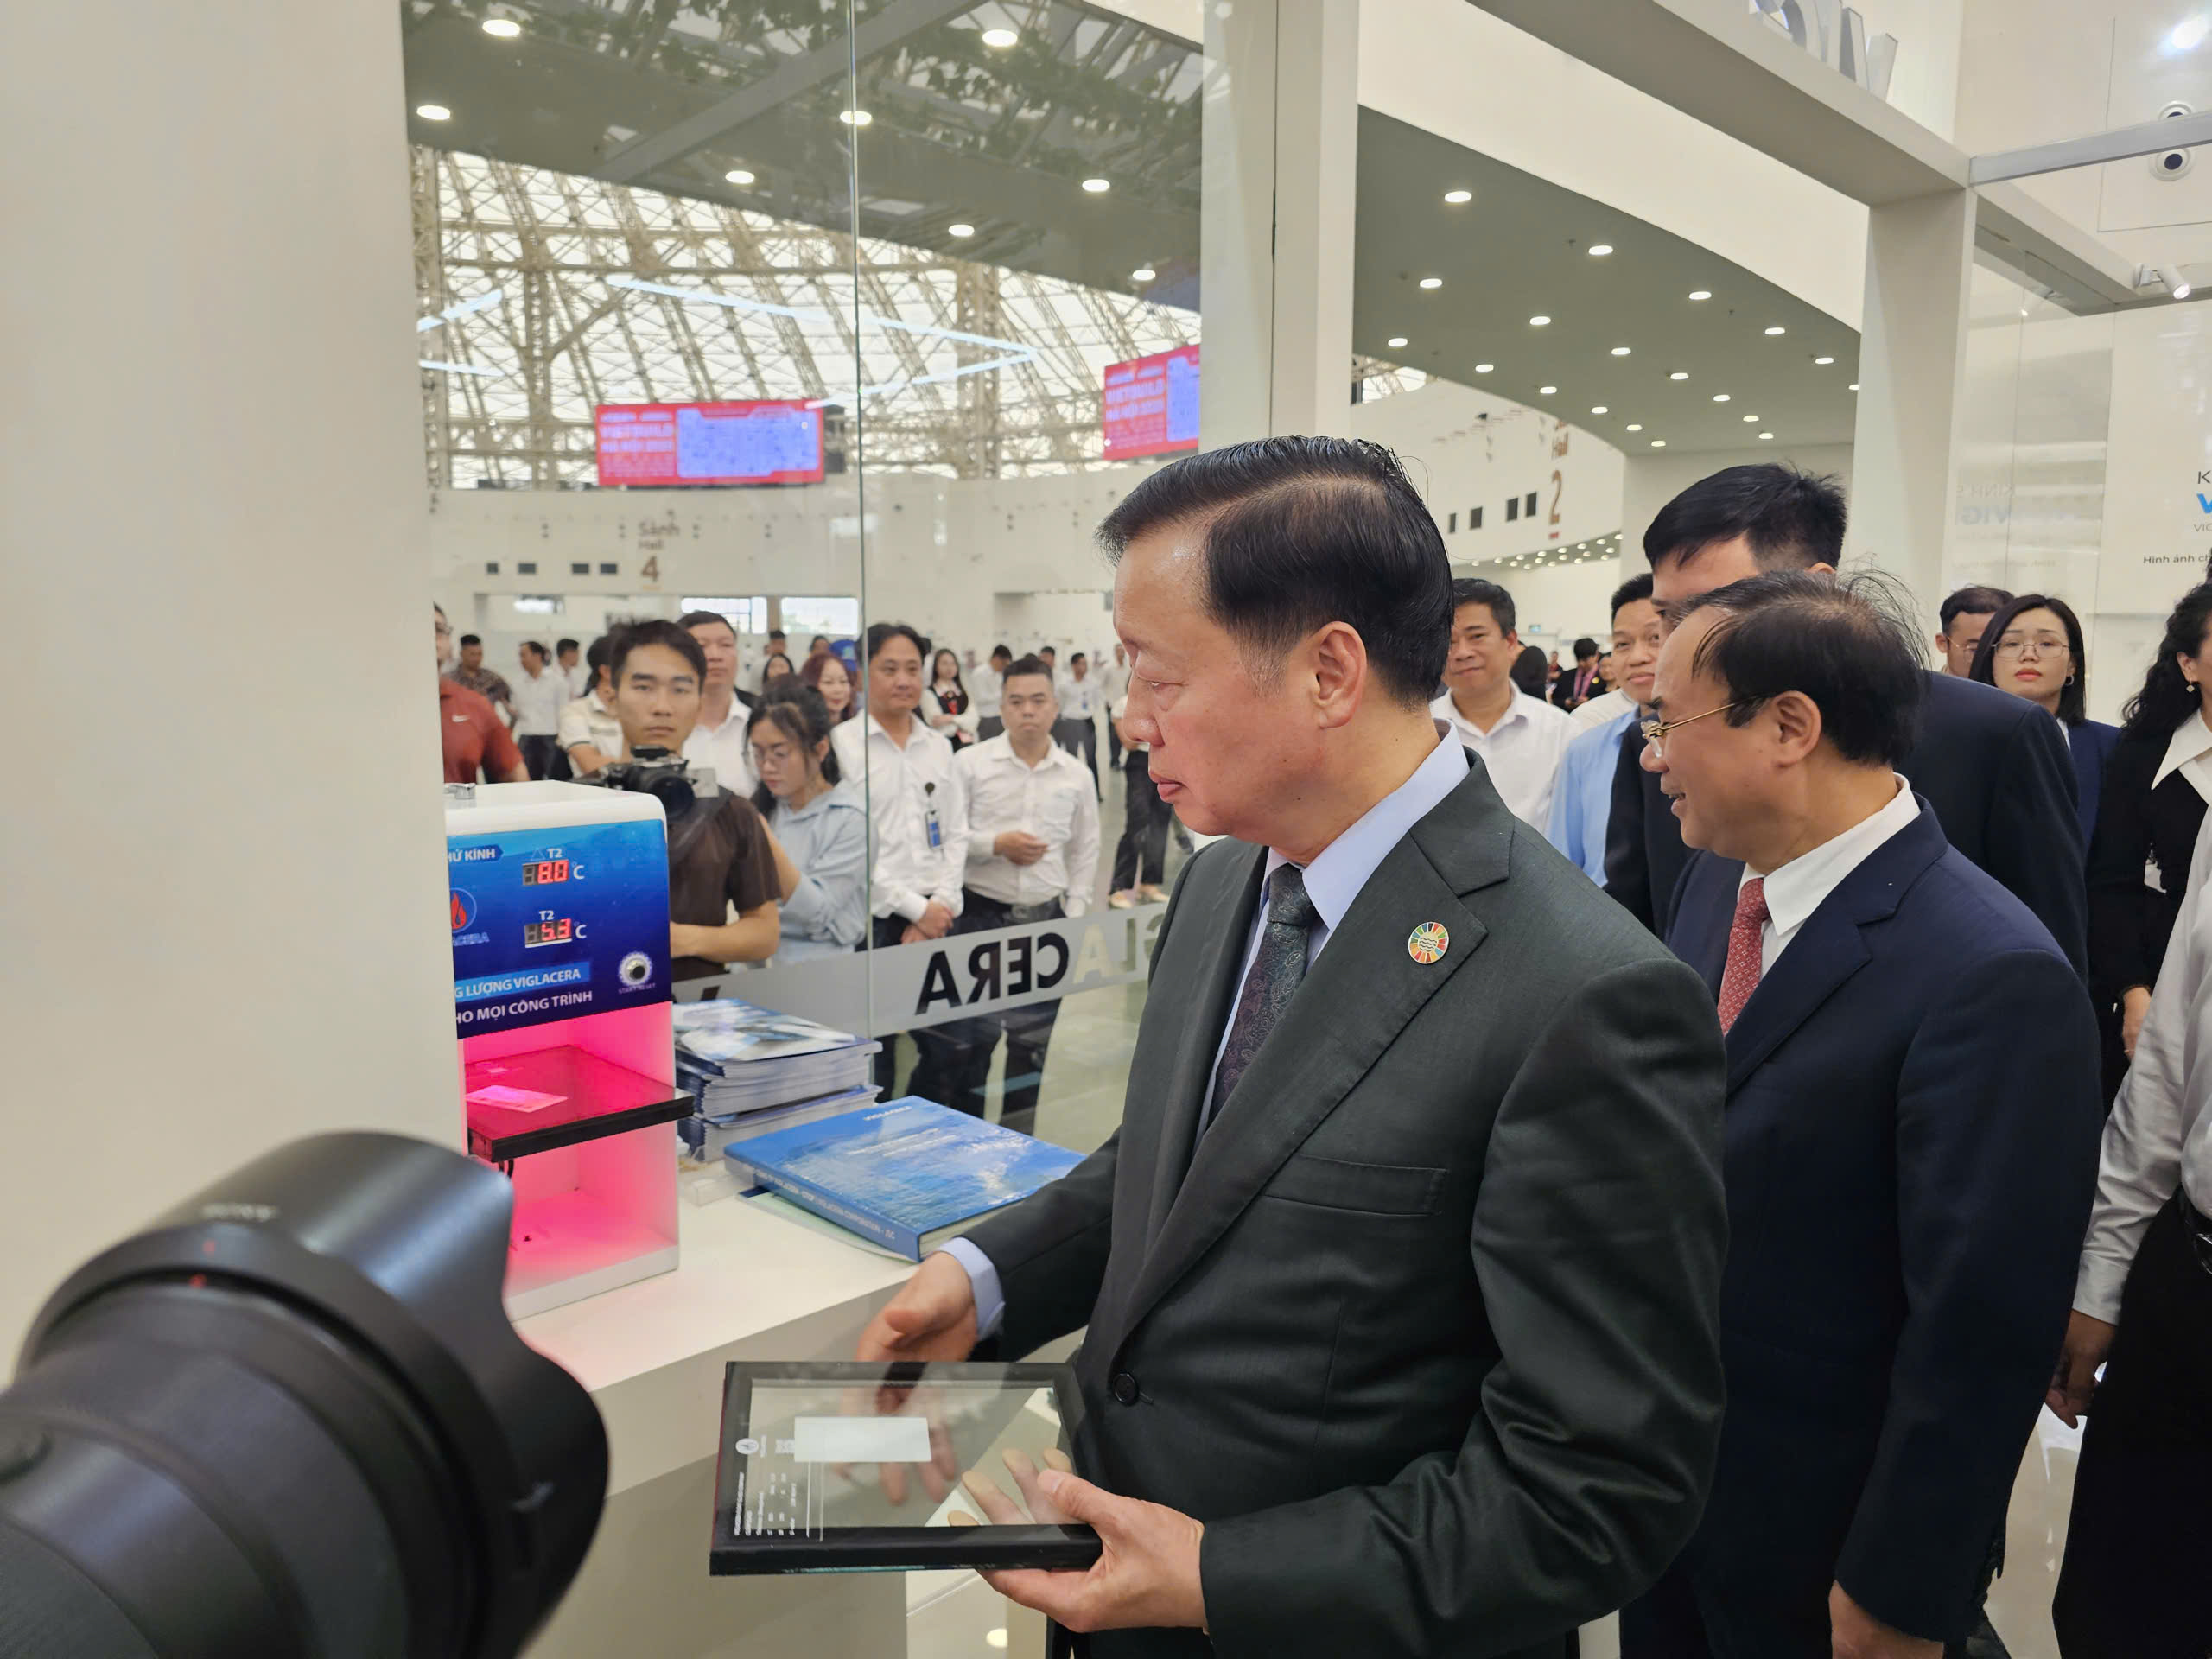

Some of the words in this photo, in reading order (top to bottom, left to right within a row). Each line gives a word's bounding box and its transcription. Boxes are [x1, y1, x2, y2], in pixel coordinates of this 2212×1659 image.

[1550, 469, 1561, 524] 2
[641, 556, 659, 582] 4
[547, 848, 563, 858] T2
[539, 910, 555, 921] T2
[513, 969, 582, 989] VIGLACERA
[477, 1005, 505, 1021] MỌI
[509, 999, 550, 1015] CÔNG
[552, 990, 593, 1007] TRÌNH
